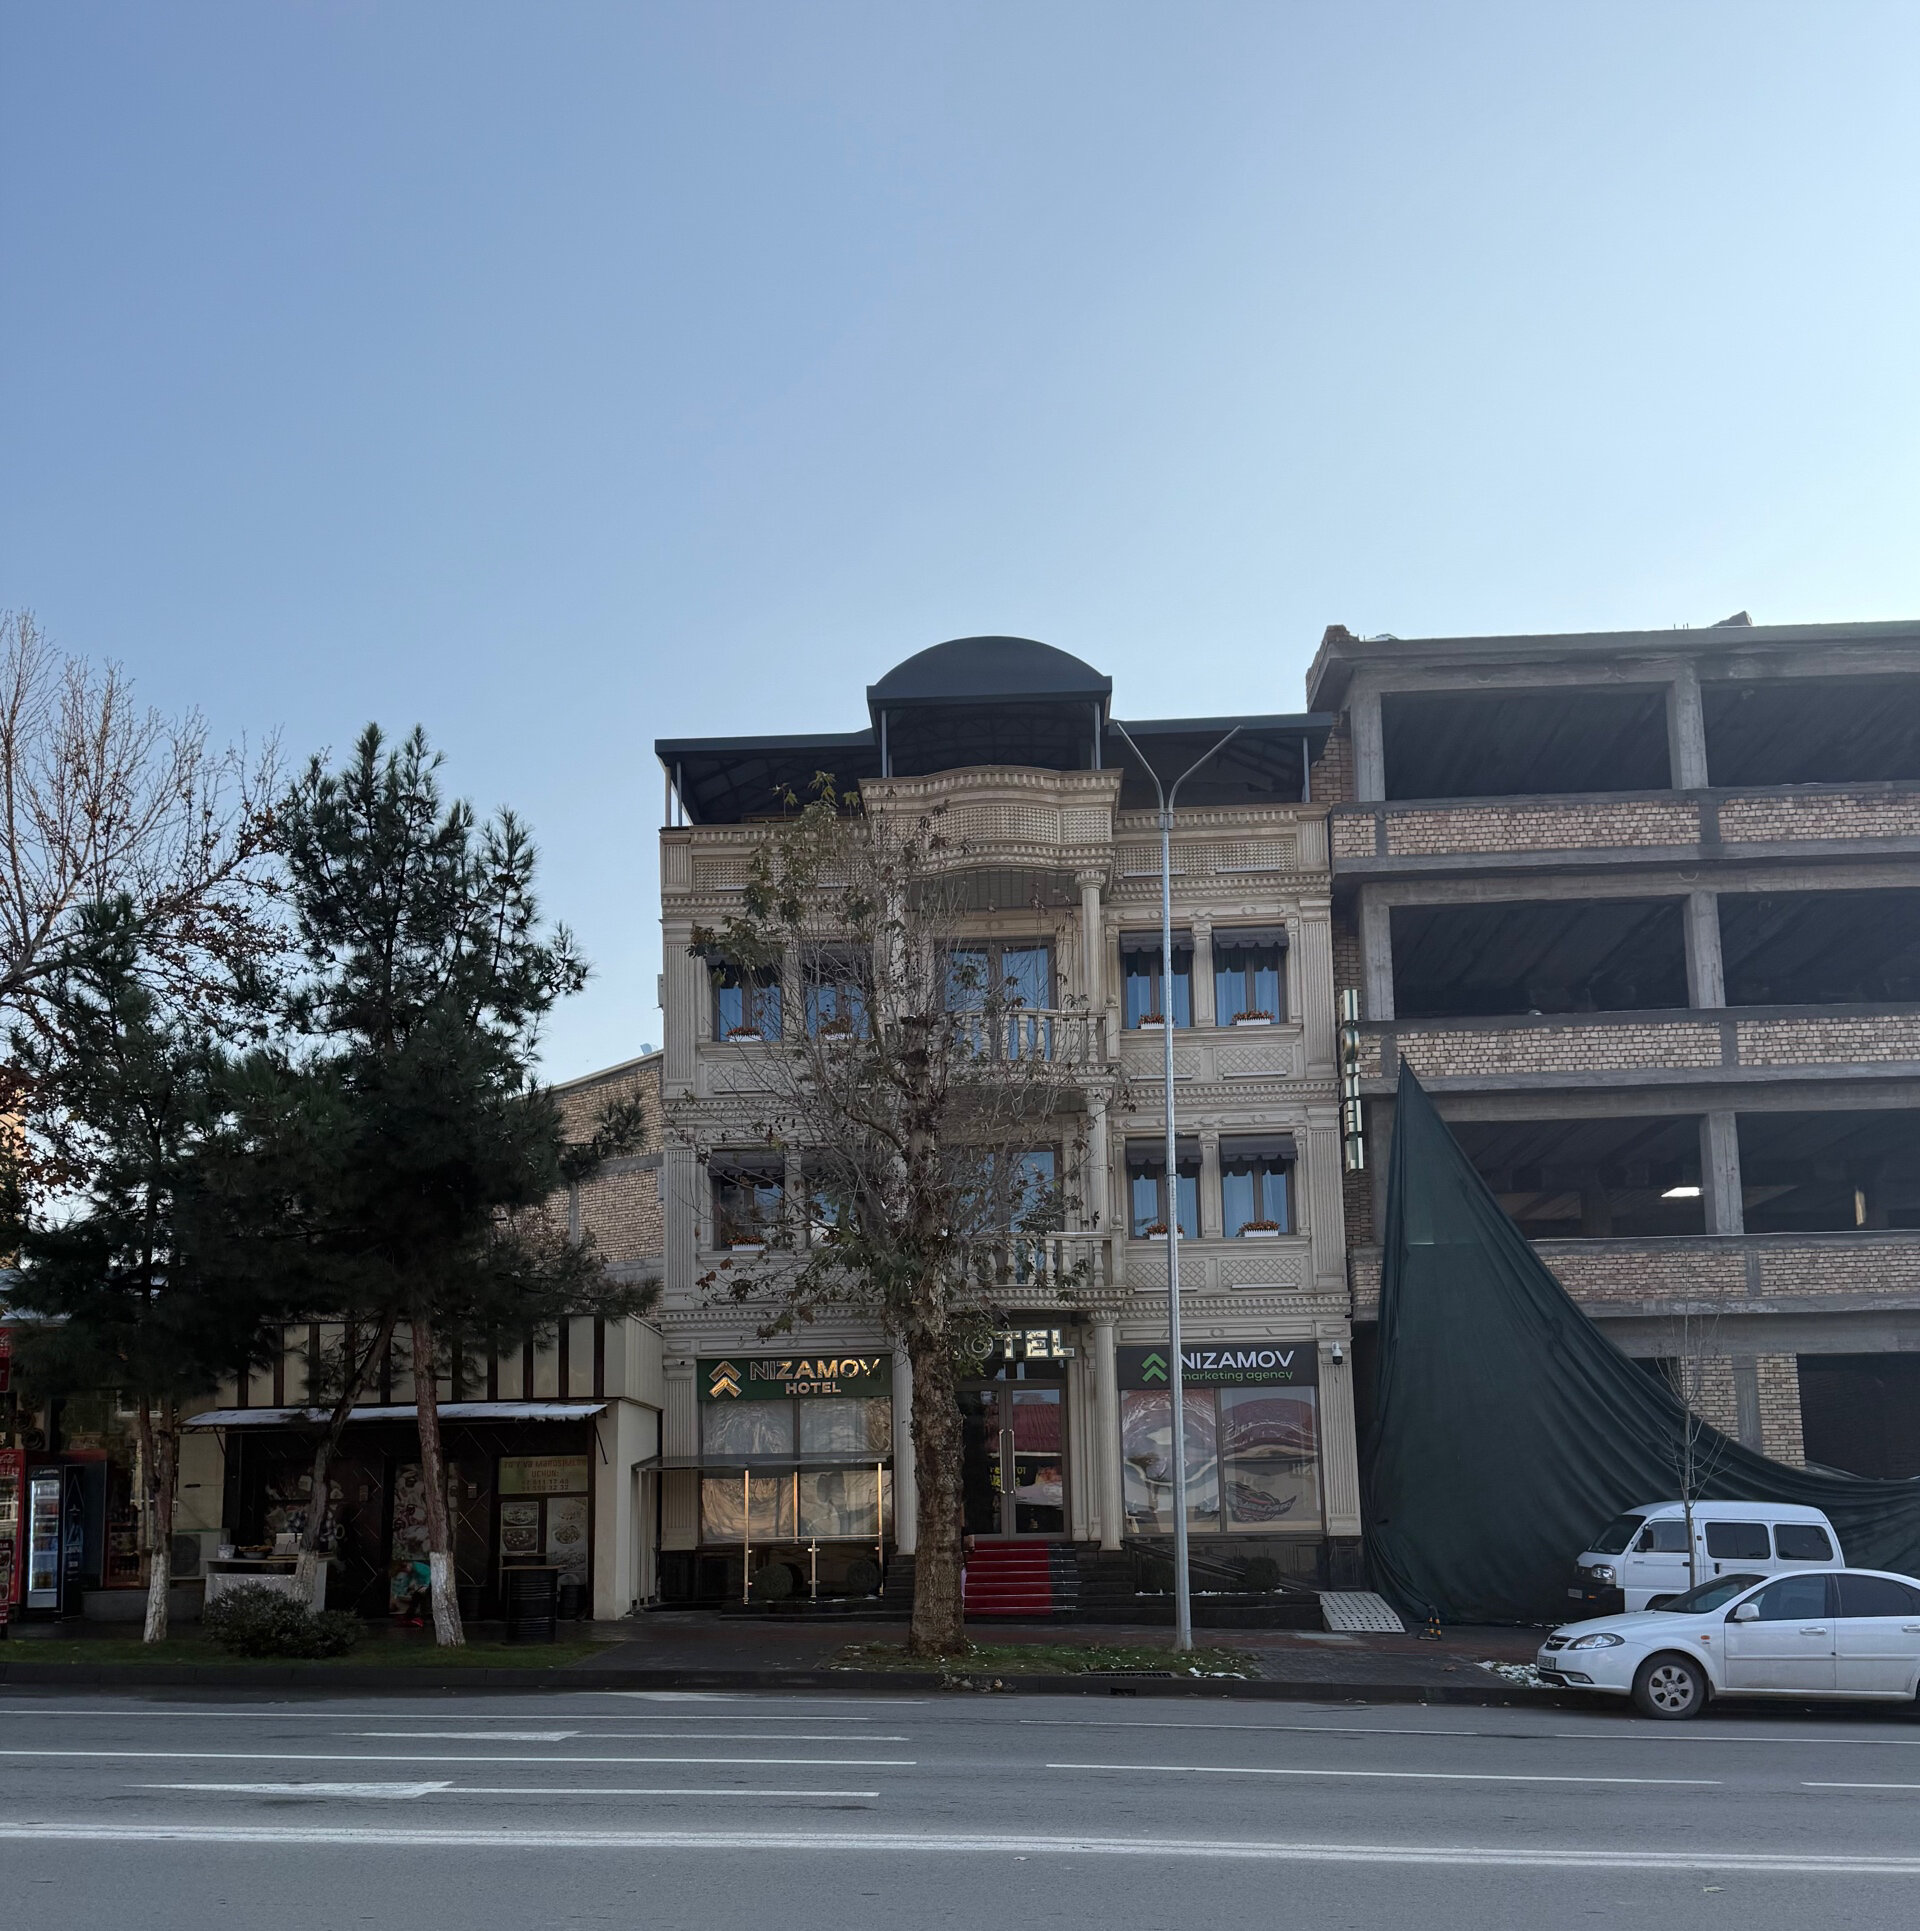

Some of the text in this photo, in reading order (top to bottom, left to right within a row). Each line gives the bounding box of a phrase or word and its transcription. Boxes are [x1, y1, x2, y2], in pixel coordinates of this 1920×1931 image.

[952, 1329, 1075, 1361] OTEL
[750, 1358, 881, 1381] NIZAMOV
[1181, 1350, 1295, 1370] NIZAMOV
[1182, 1371, 1293, 1382] marketing agency
[785, 1382, 842, 1395] HOTEL
